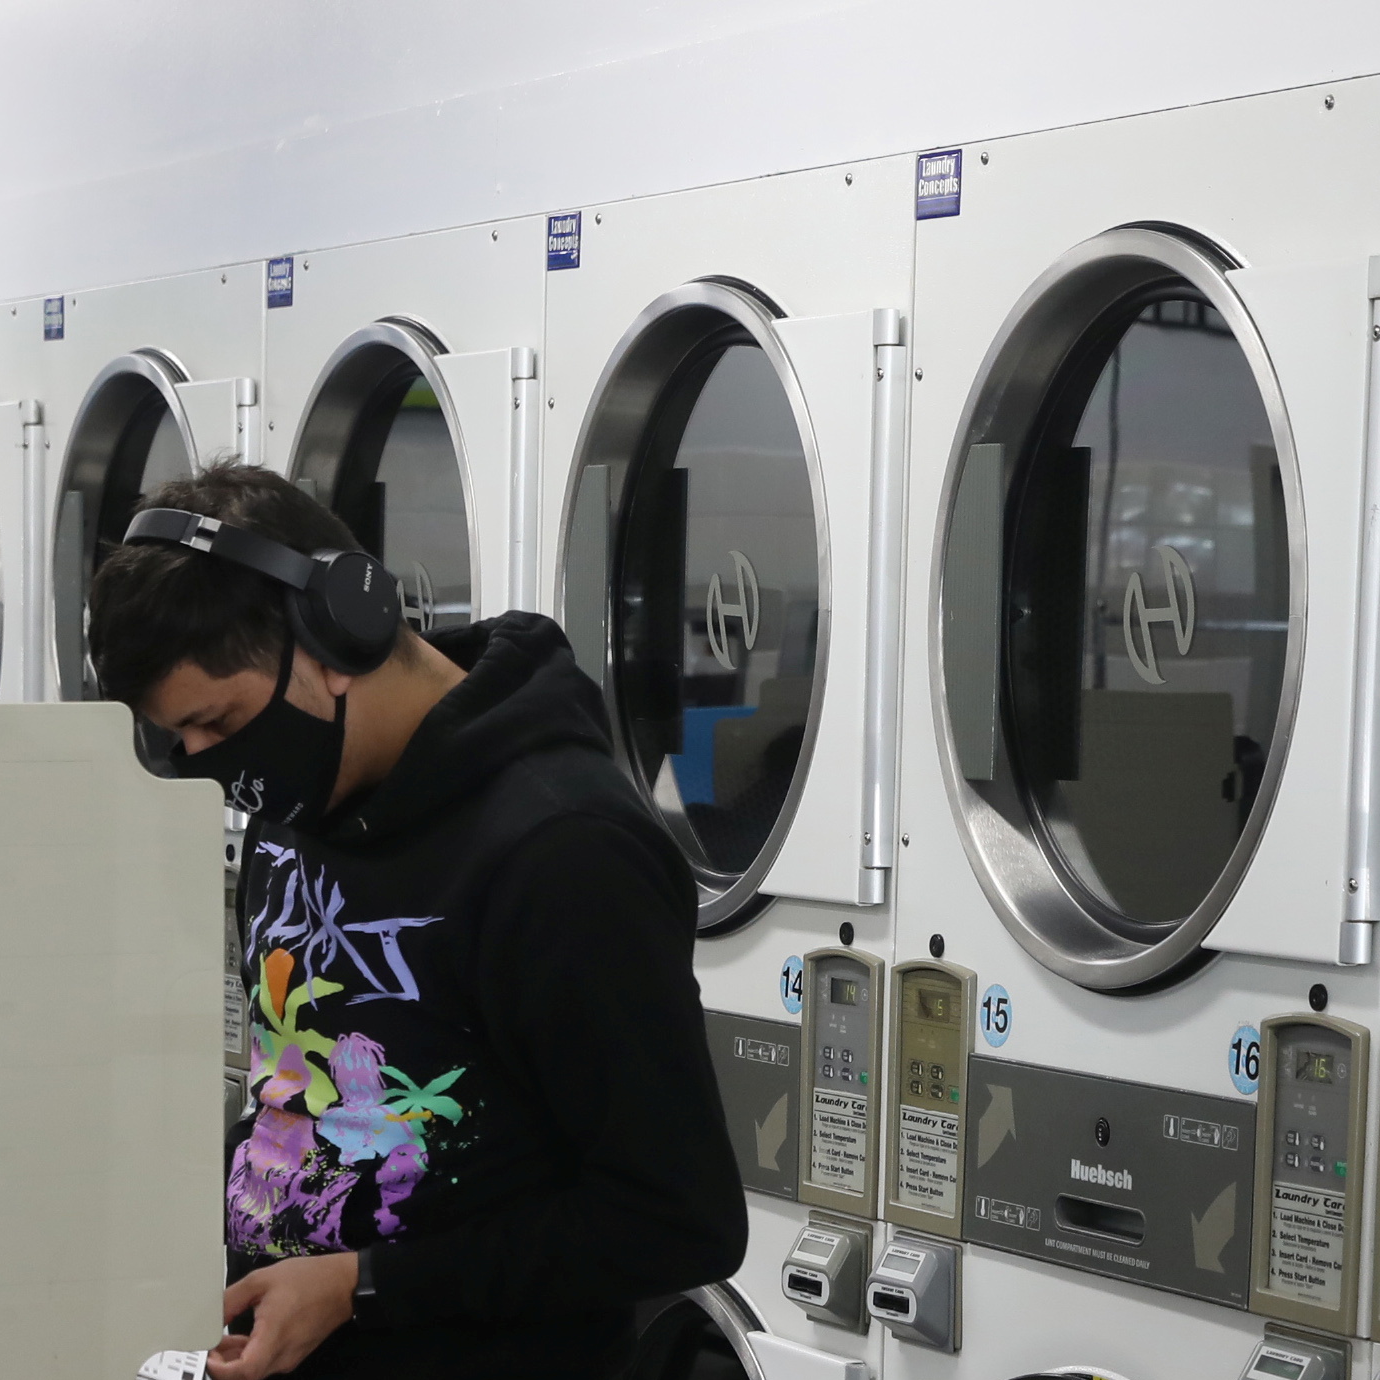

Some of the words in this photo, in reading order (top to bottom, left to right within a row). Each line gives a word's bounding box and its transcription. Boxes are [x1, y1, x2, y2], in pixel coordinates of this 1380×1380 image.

[923, 157, 955, 176] Laundry
[918, 176, 958, 196] Concepts
[363, 563, 372, 593] SONY
[783, 967, 802, 1002] 14
[983, 997, 1008, 1033] 15
[1232, 1038, 1259, 1080] 16
[816, 1095, 848, 1109] Laundry
[852, 1101, 867, 1111] Car
[902, 1112, 938, 1128] Laundry
[941, 1120, 958, 1130] Car
[1071, 1158, 1132, 1190] Huebsch
[1275, 1189, 1319, 1207] Laundry
[1324, 1197, 1345, 1210] Car
[1045, 1238, 1055, 1247] LINT
[1056, 1241, 1091, 1255] COMPARTMENT
[1092, 1249, 1105, 1258] MUST
[1107, 1253, 1112, 1261] BE
[1114, 1255, 1135, 1266] CLEANED
[1136, 1260, 1150, 1269] DAILY
